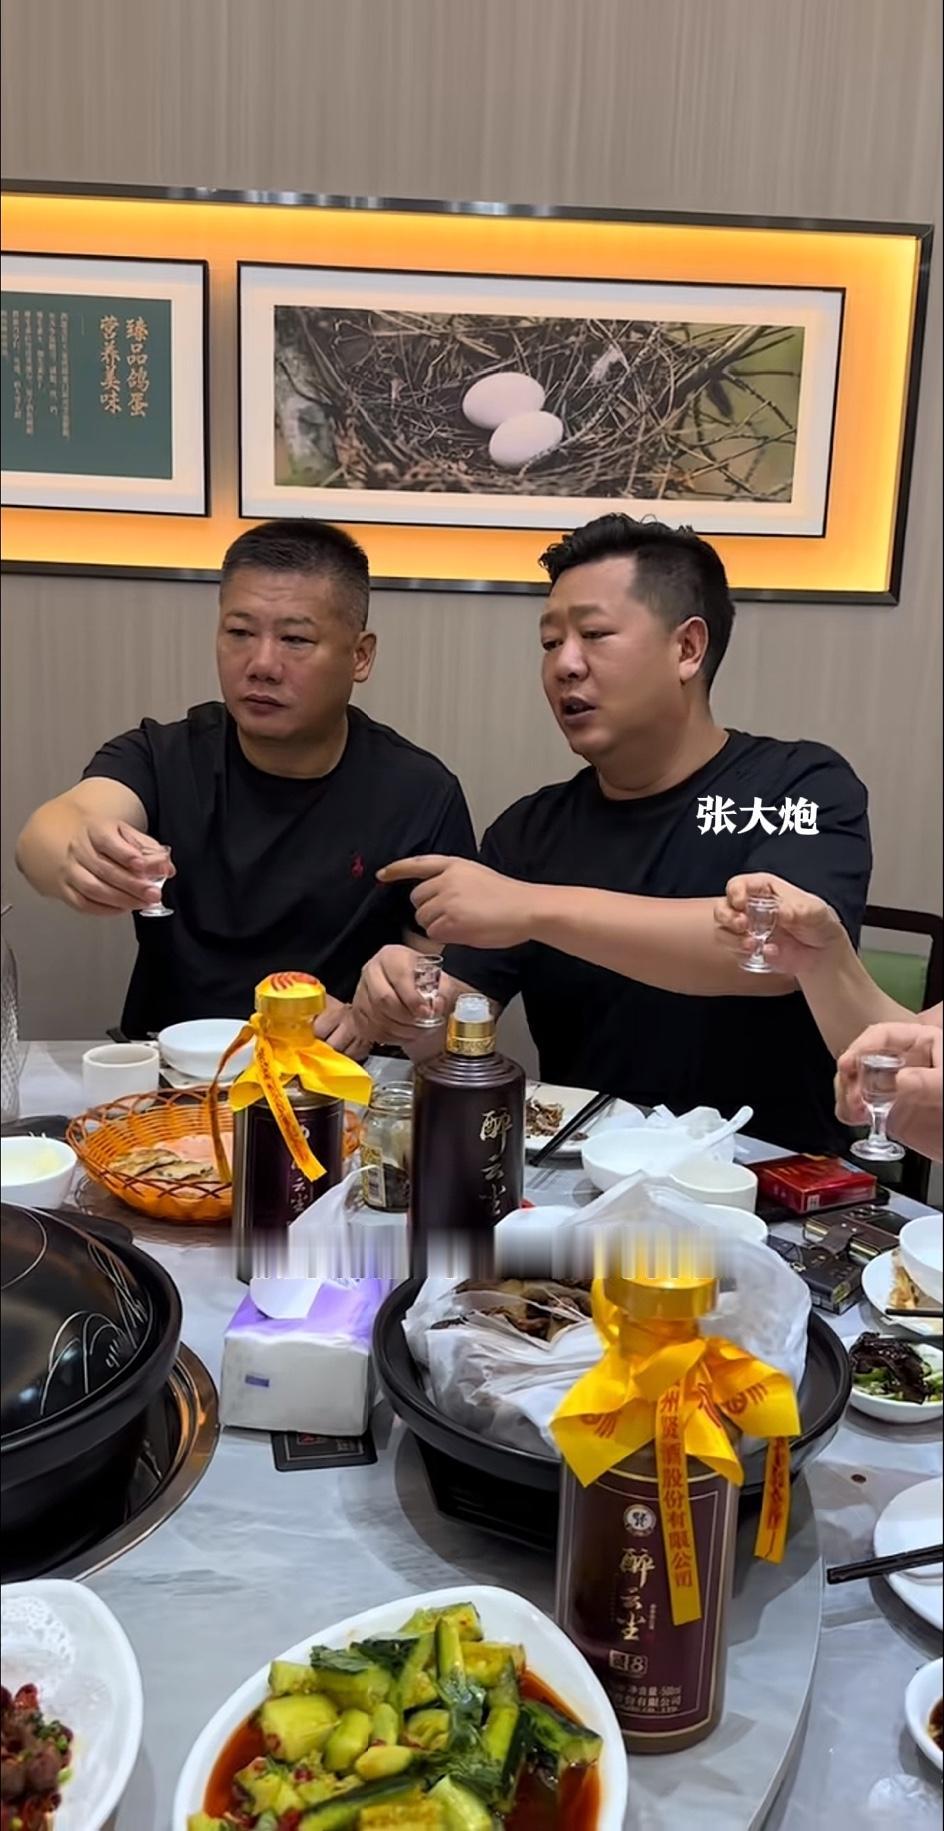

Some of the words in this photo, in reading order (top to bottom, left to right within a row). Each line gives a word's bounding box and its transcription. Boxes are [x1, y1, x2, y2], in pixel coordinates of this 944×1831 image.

[100, 314, 122, 414] 营养美味
[126, 315, 150, 417] 臻品鸽蛋
